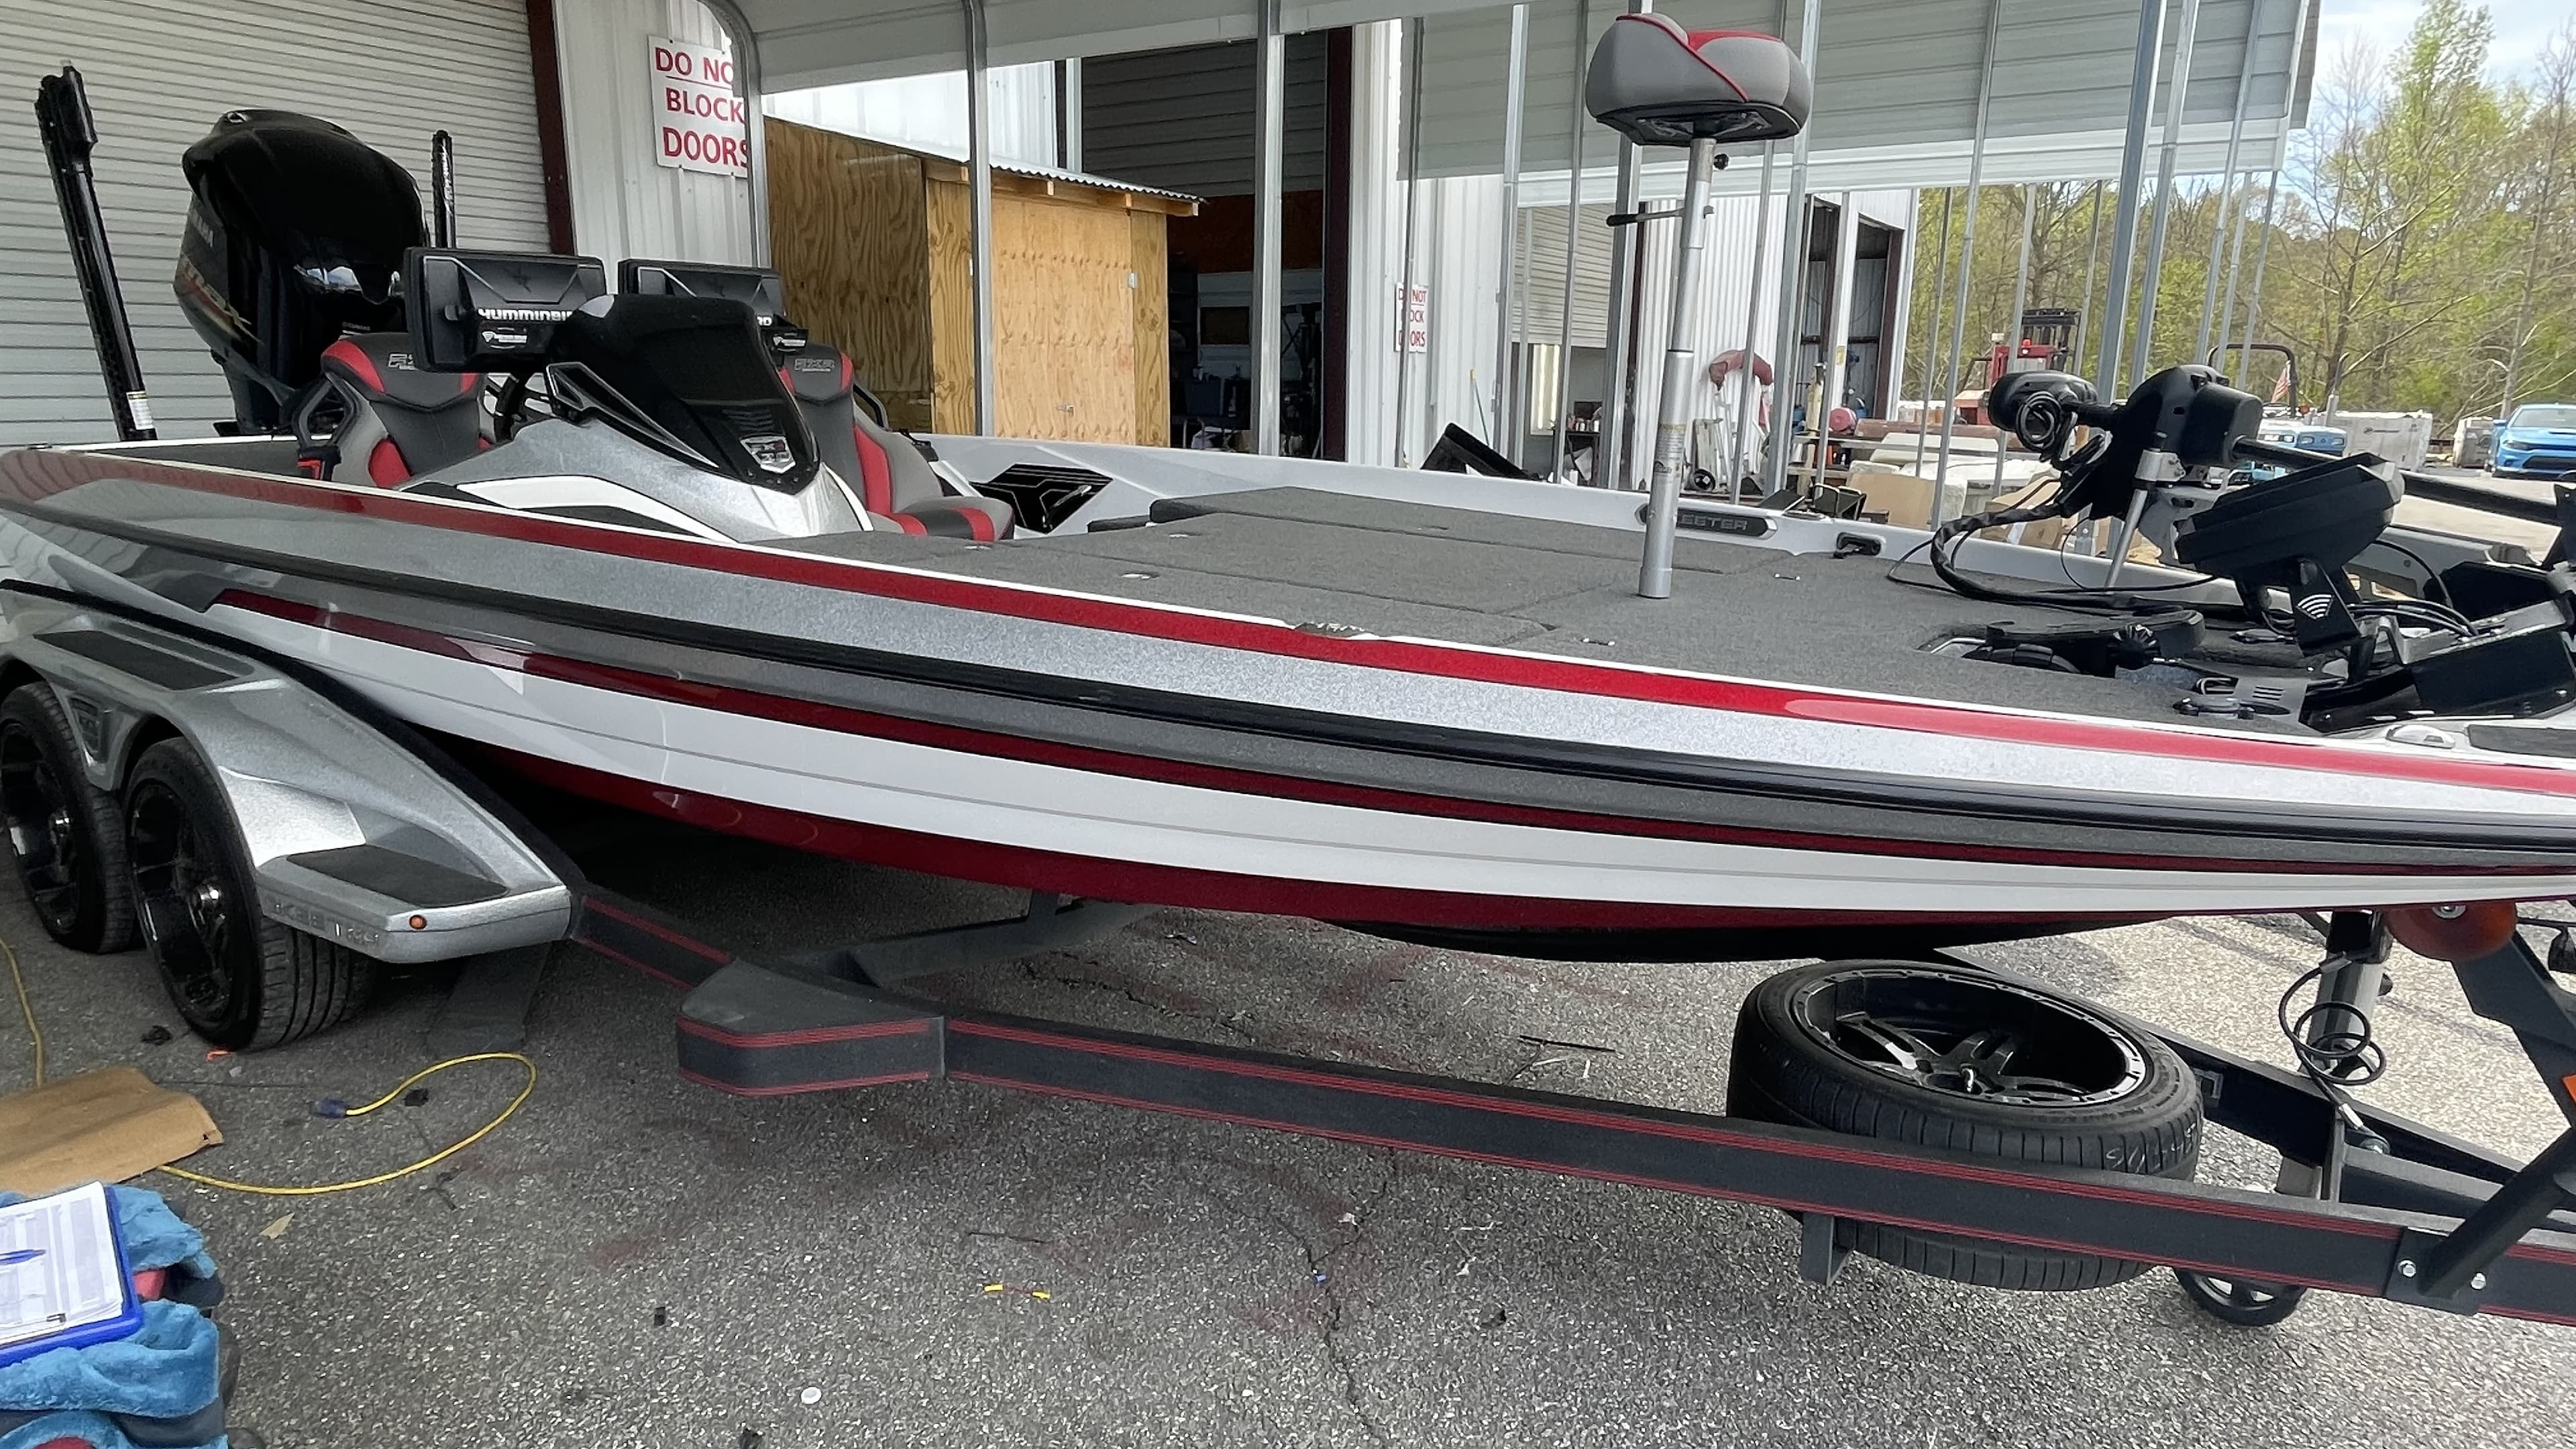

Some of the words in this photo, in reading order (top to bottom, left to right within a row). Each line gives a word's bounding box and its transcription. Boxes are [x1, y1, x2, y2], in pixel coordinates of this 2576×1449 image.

[655, 47, 692, 76] DO
[703, 57, 733, 85] NO
[665, 87, 745, 125] BLOCK
[663, 126, 747, 168] DOORS
[1412, 290, 1427, 303] NOT
[478, 309, 573, 321] HUMMINBI
[1682, 514, 1748, 531] EETER
